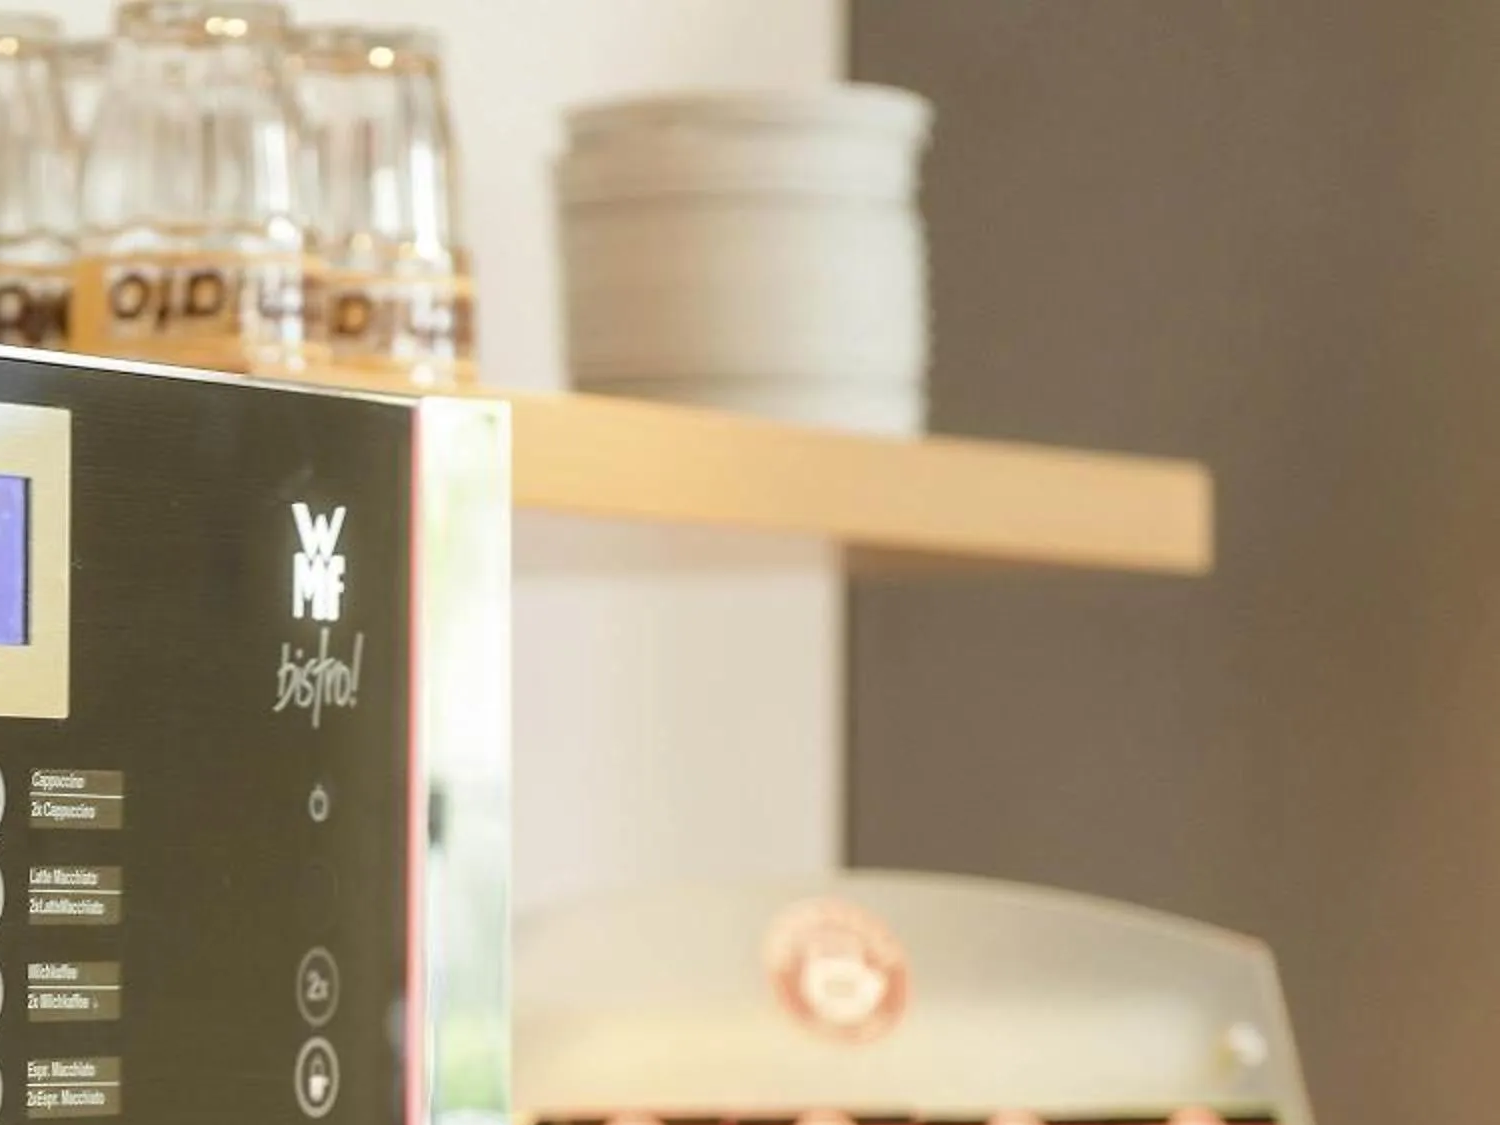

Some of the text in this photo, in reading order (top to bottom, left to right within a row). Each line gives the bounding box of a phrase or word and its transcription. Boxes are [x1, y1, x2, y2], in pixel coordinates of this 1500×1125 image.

[31, 771, 86, 791] Cappuccino
[31, 801, 96, 822] 2x Cappuccino
[53, 867, 99, 886] Macchiato
[51, 1061, 97, 1078] Macchiato
[61, 1089, 106, 1106] Macchiato
